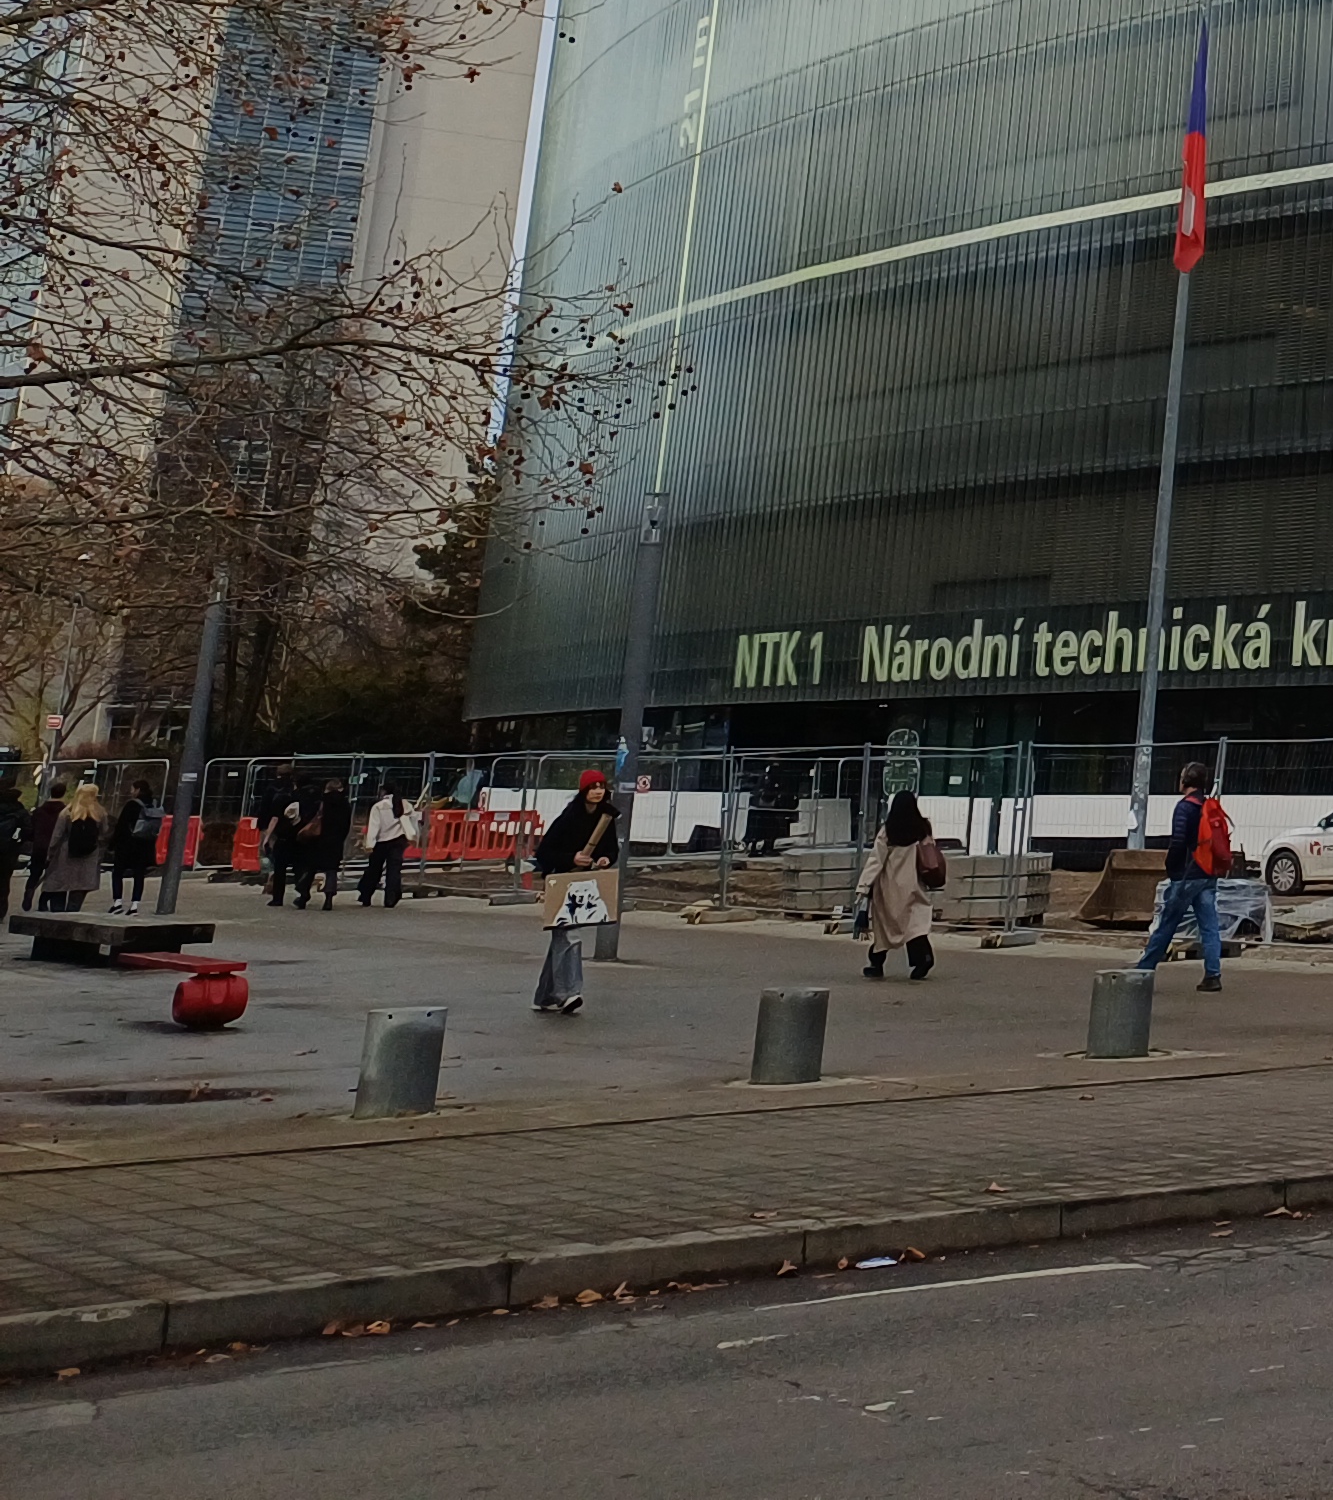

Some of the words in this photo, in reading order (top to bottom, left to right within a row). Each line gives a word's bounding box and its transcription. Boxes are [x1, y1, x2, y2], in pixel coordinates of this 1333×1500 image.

[692, 16, 711, 69] m
[733, 631, 801, 688] NTK
[809, 631, 824, 685] 1
[860, 617, 1025, 683] Národní
